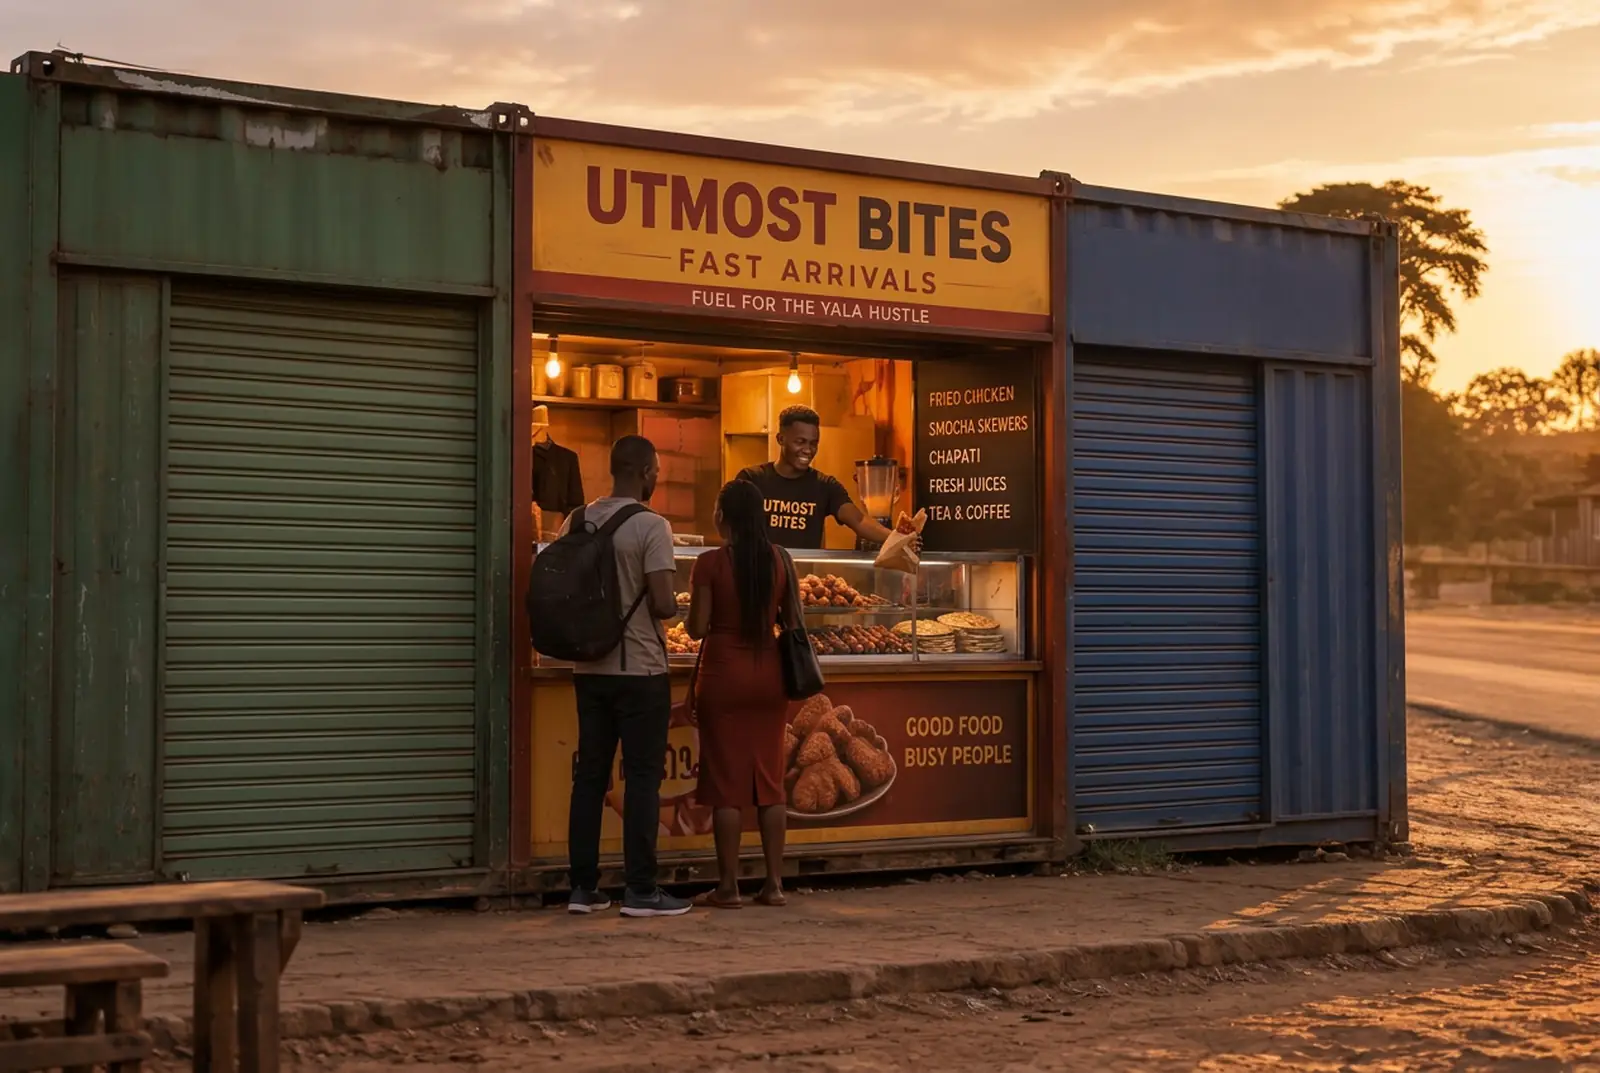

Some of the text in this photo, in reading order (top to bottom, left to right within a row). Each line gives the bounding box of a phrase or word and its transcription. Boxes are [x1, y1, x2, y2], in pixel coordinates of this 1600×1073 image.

[586, 165, 1012, 264] UTMOST BITES
[679, 247, 937, 295] FAST ARRIVALS
[692, 290, 930, 324] FUEL FOR THE YALA HUSTLE
[929, 415, 1028, 437] SMOCHA SKEWERS
[929, 448, 981, 465] CHAPATI
[929, 476, 1007, 493] FRESH JUICES
[763, 499, 816, 516] UTMOST
[929, 504, 1011, 521] TEA & COFFEE
[770, 514, 807, 530] BITES
[906, 715, 1003, 737] GOOD FOOD
[904, 744, 1012, 767] BUSY PEOPLE
